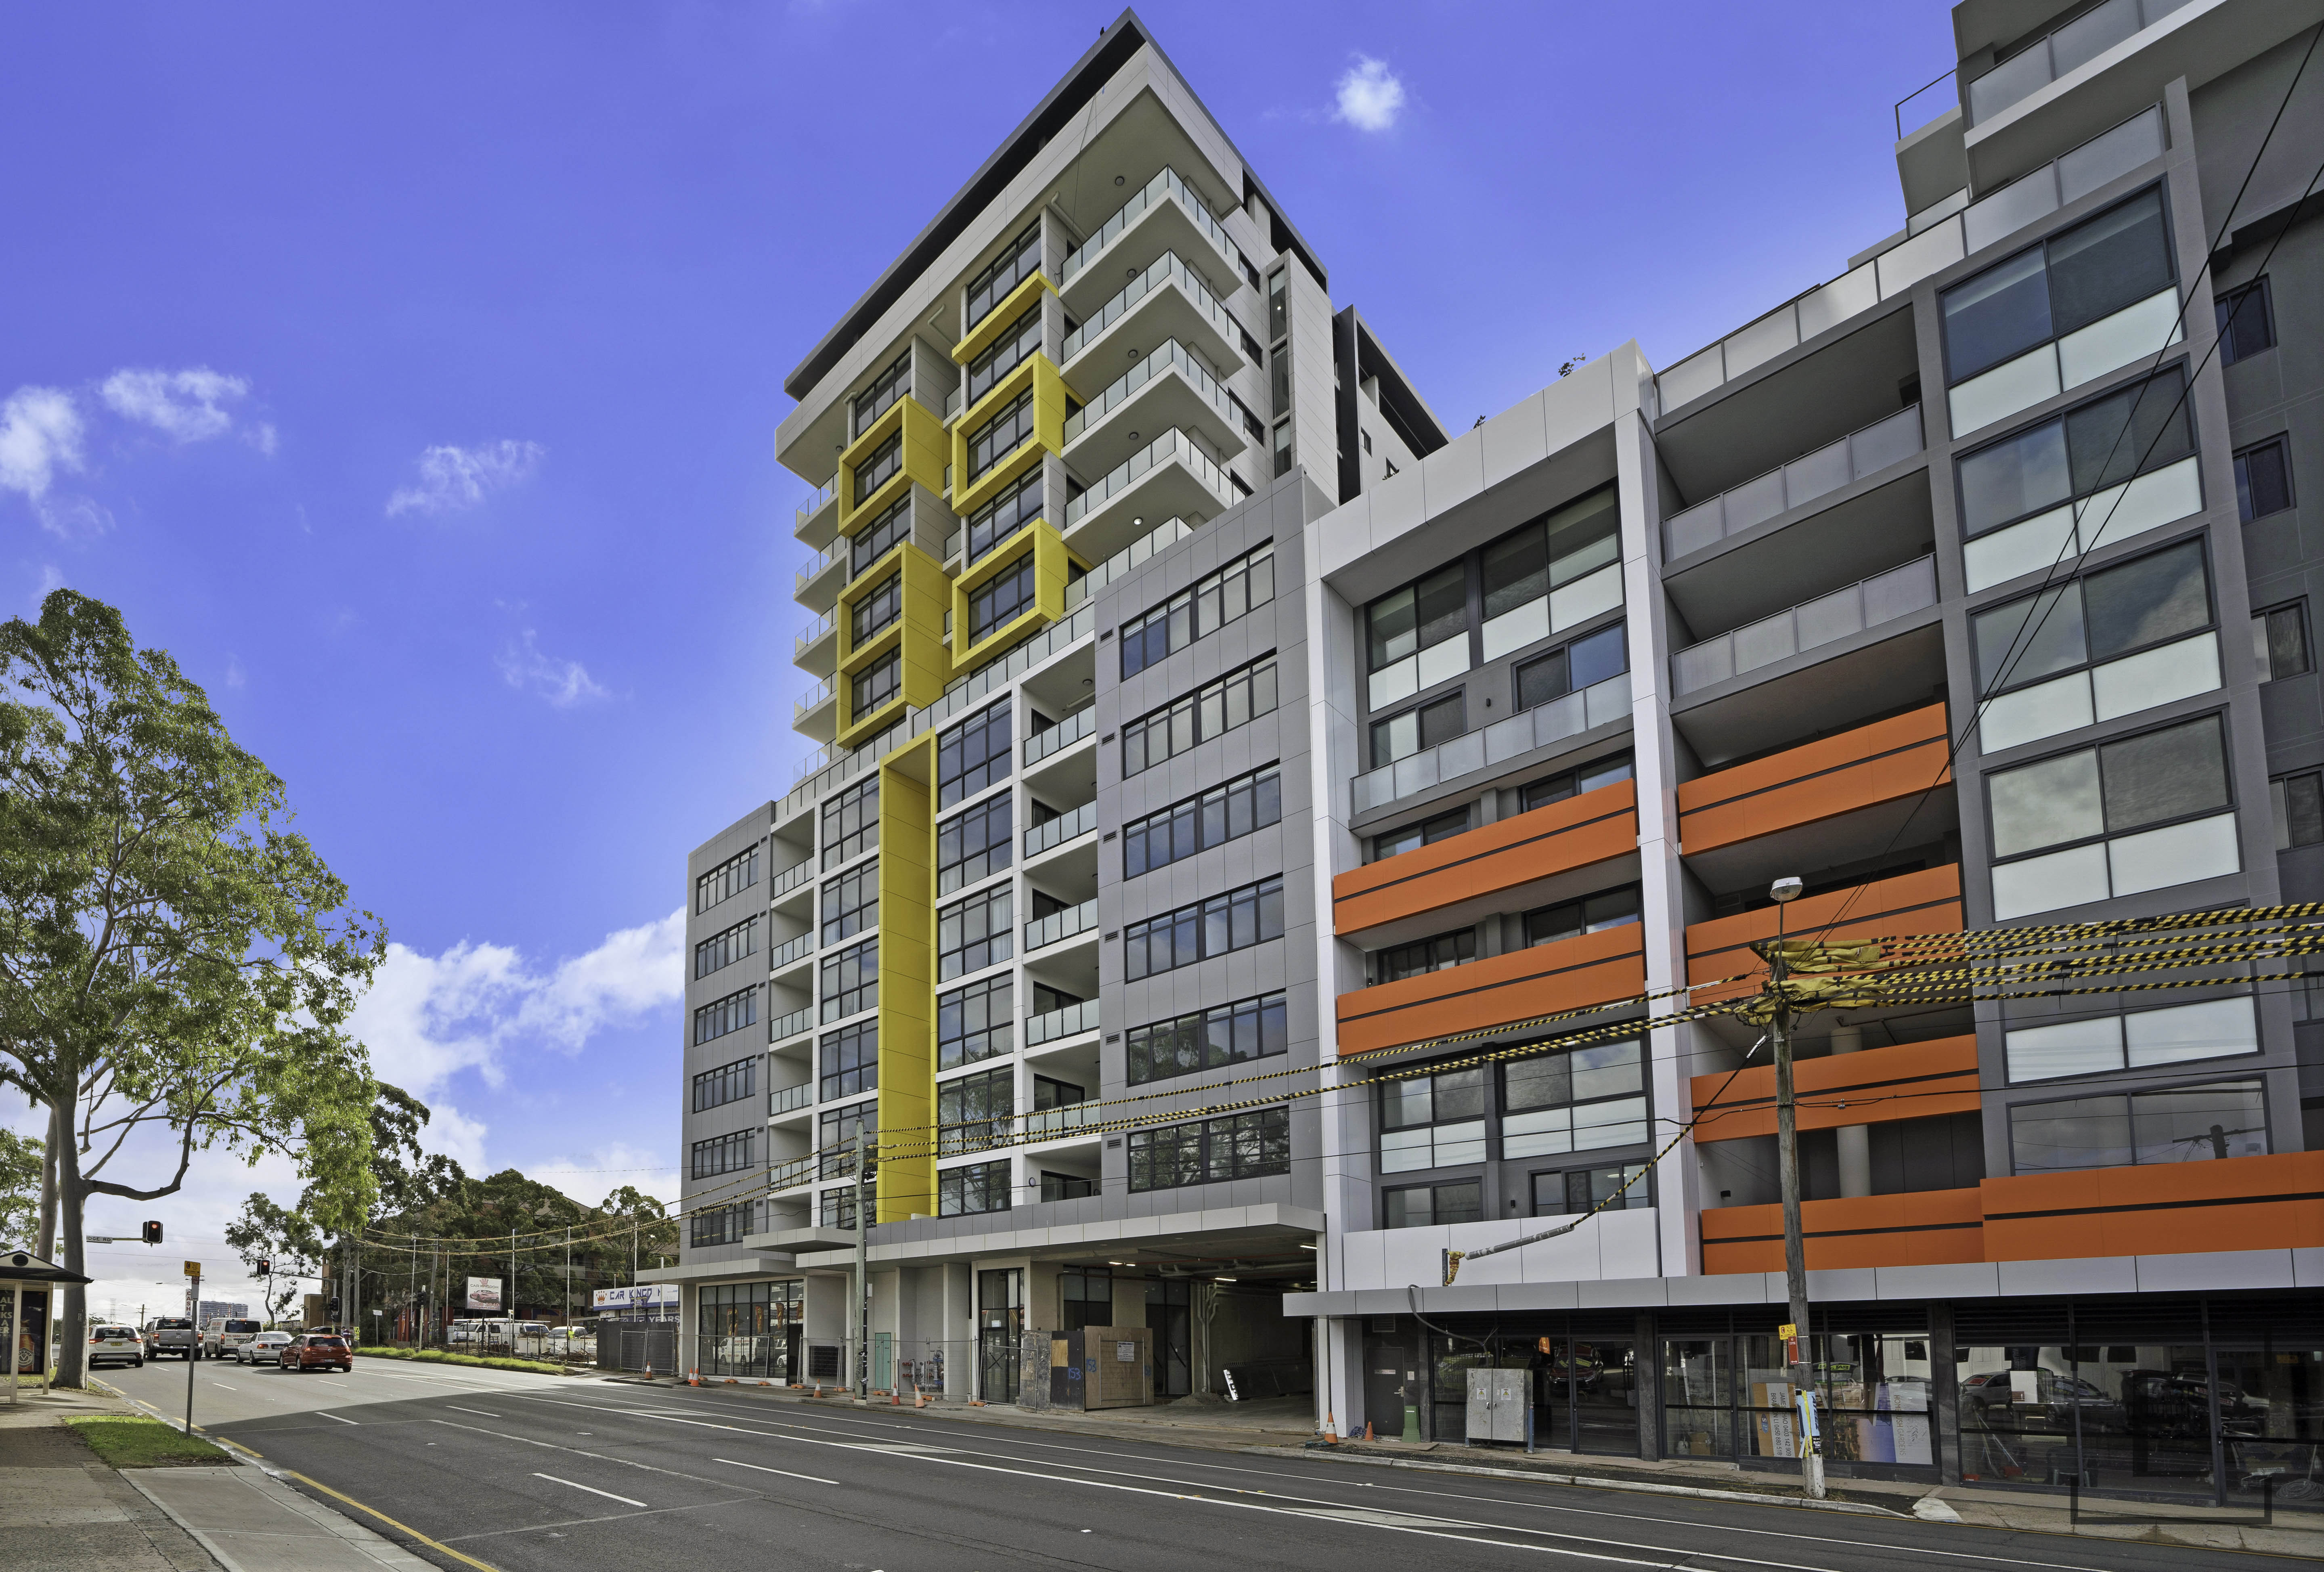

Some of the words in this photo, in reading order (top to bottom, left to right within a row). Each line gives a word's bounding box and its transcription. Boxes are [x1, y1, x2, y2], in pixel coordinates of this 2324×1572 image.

[610, 1291, 624, 1301] CAR
[1086, 1358, 1096, 1372] 153
[1068, 1367, 1081, 1380] 153
[1894, 1395, 1903, 1427] HOMEUSH
[1897, 1429, 1906, 1456] GARDENS
